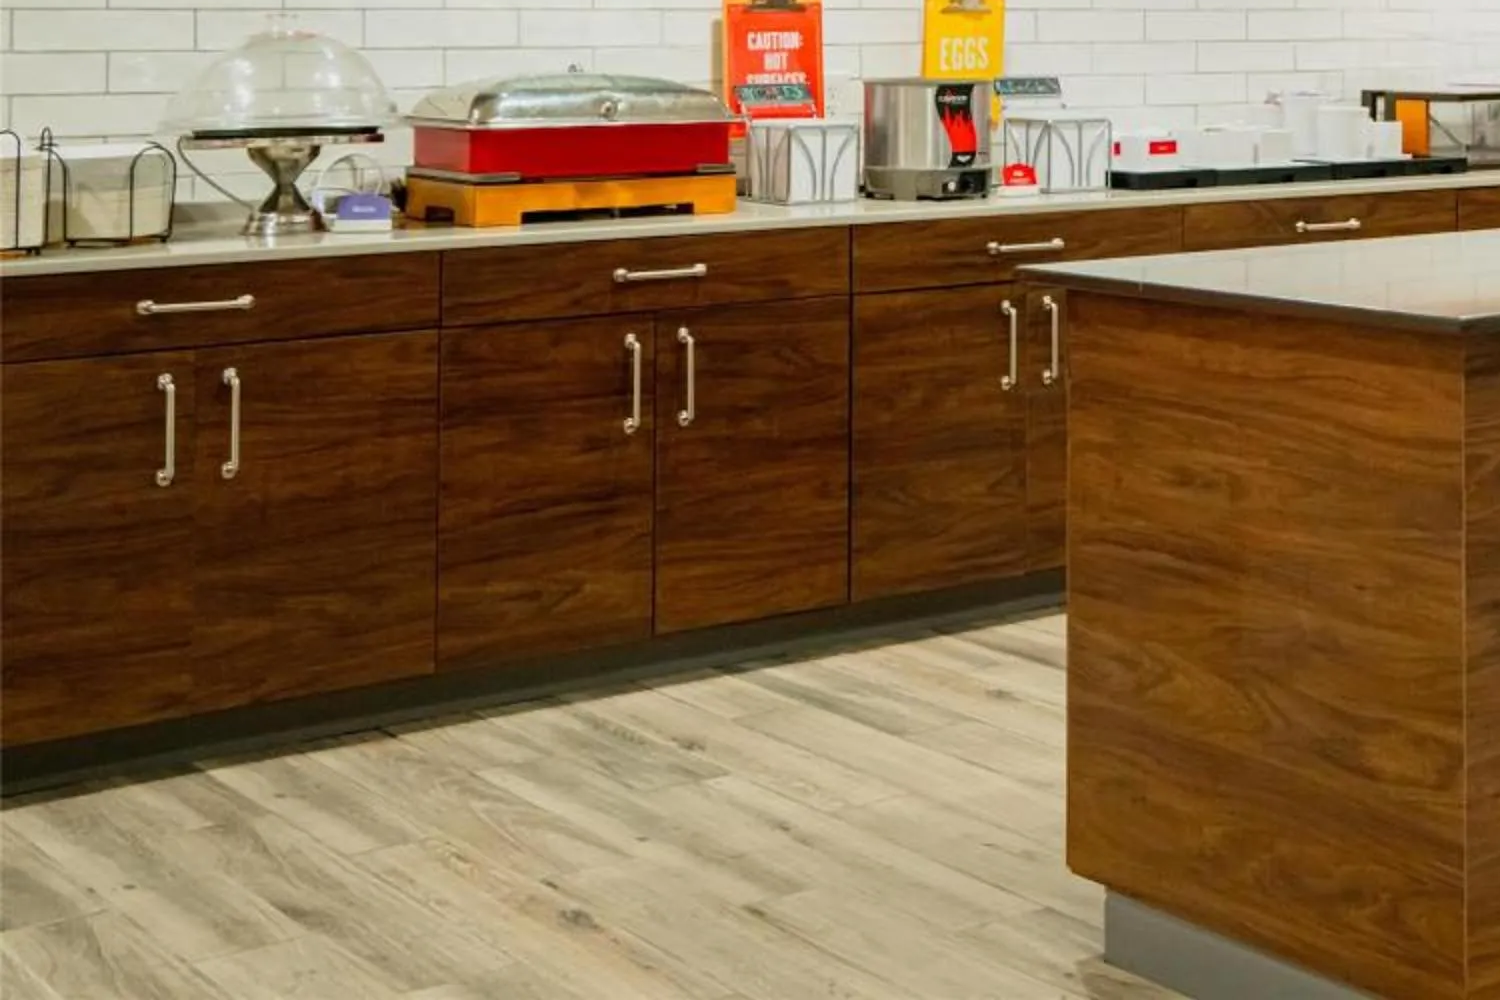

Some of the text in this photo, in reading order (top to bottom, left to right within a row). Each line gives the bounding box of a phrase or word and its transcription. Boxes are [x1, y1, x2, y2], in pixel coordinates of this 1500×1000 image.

[747, 31, 804, 50] CAUTION:
[764, 52, 788, 71] HOT
[940, 37, 990, 71] EGGS
